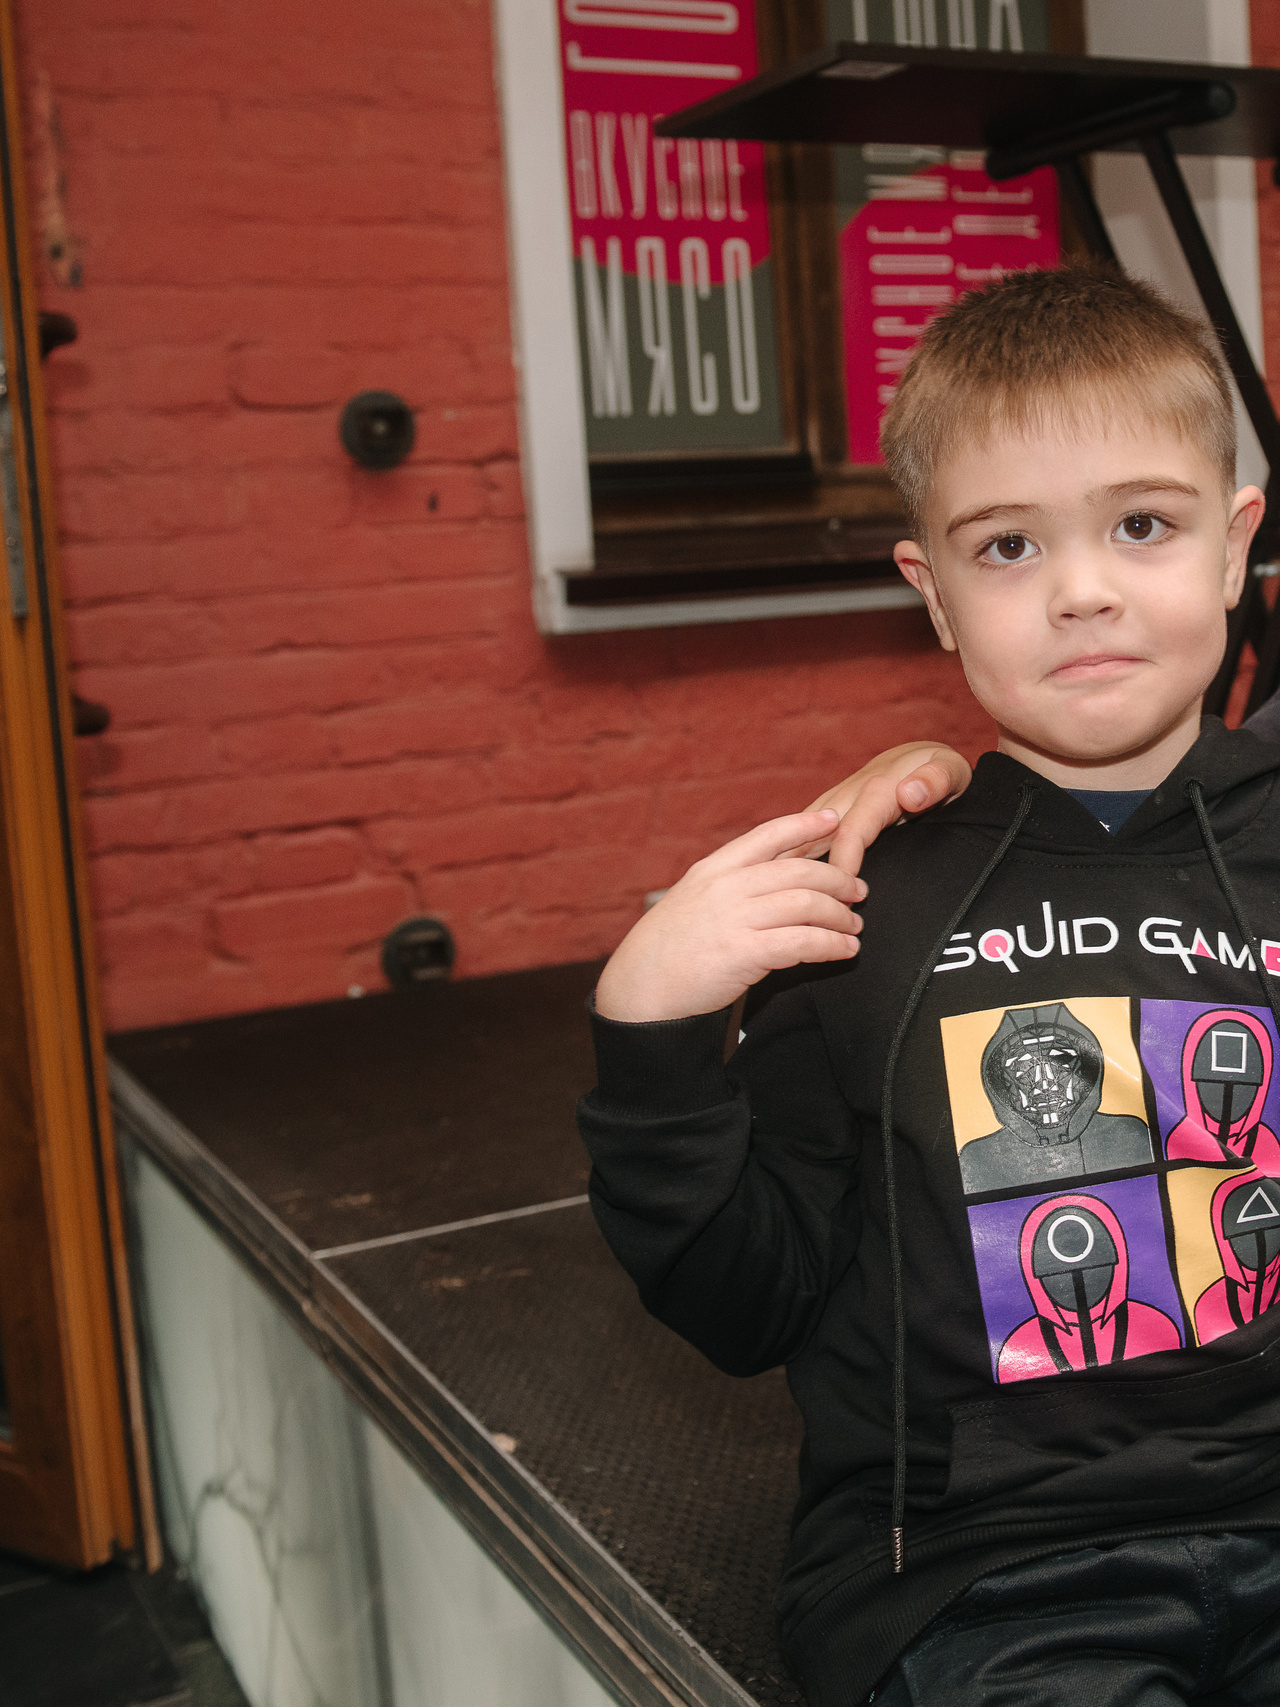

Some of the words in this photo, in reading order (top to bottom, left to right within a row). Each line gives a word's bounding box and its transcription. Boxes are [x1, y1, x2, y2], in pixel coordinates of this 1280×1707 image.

[569, 109, 749, 222] ВКУСНОЕ
[580, 235, 761, 418] МЯСО
[933, 901, 1120, 974] SQUID
